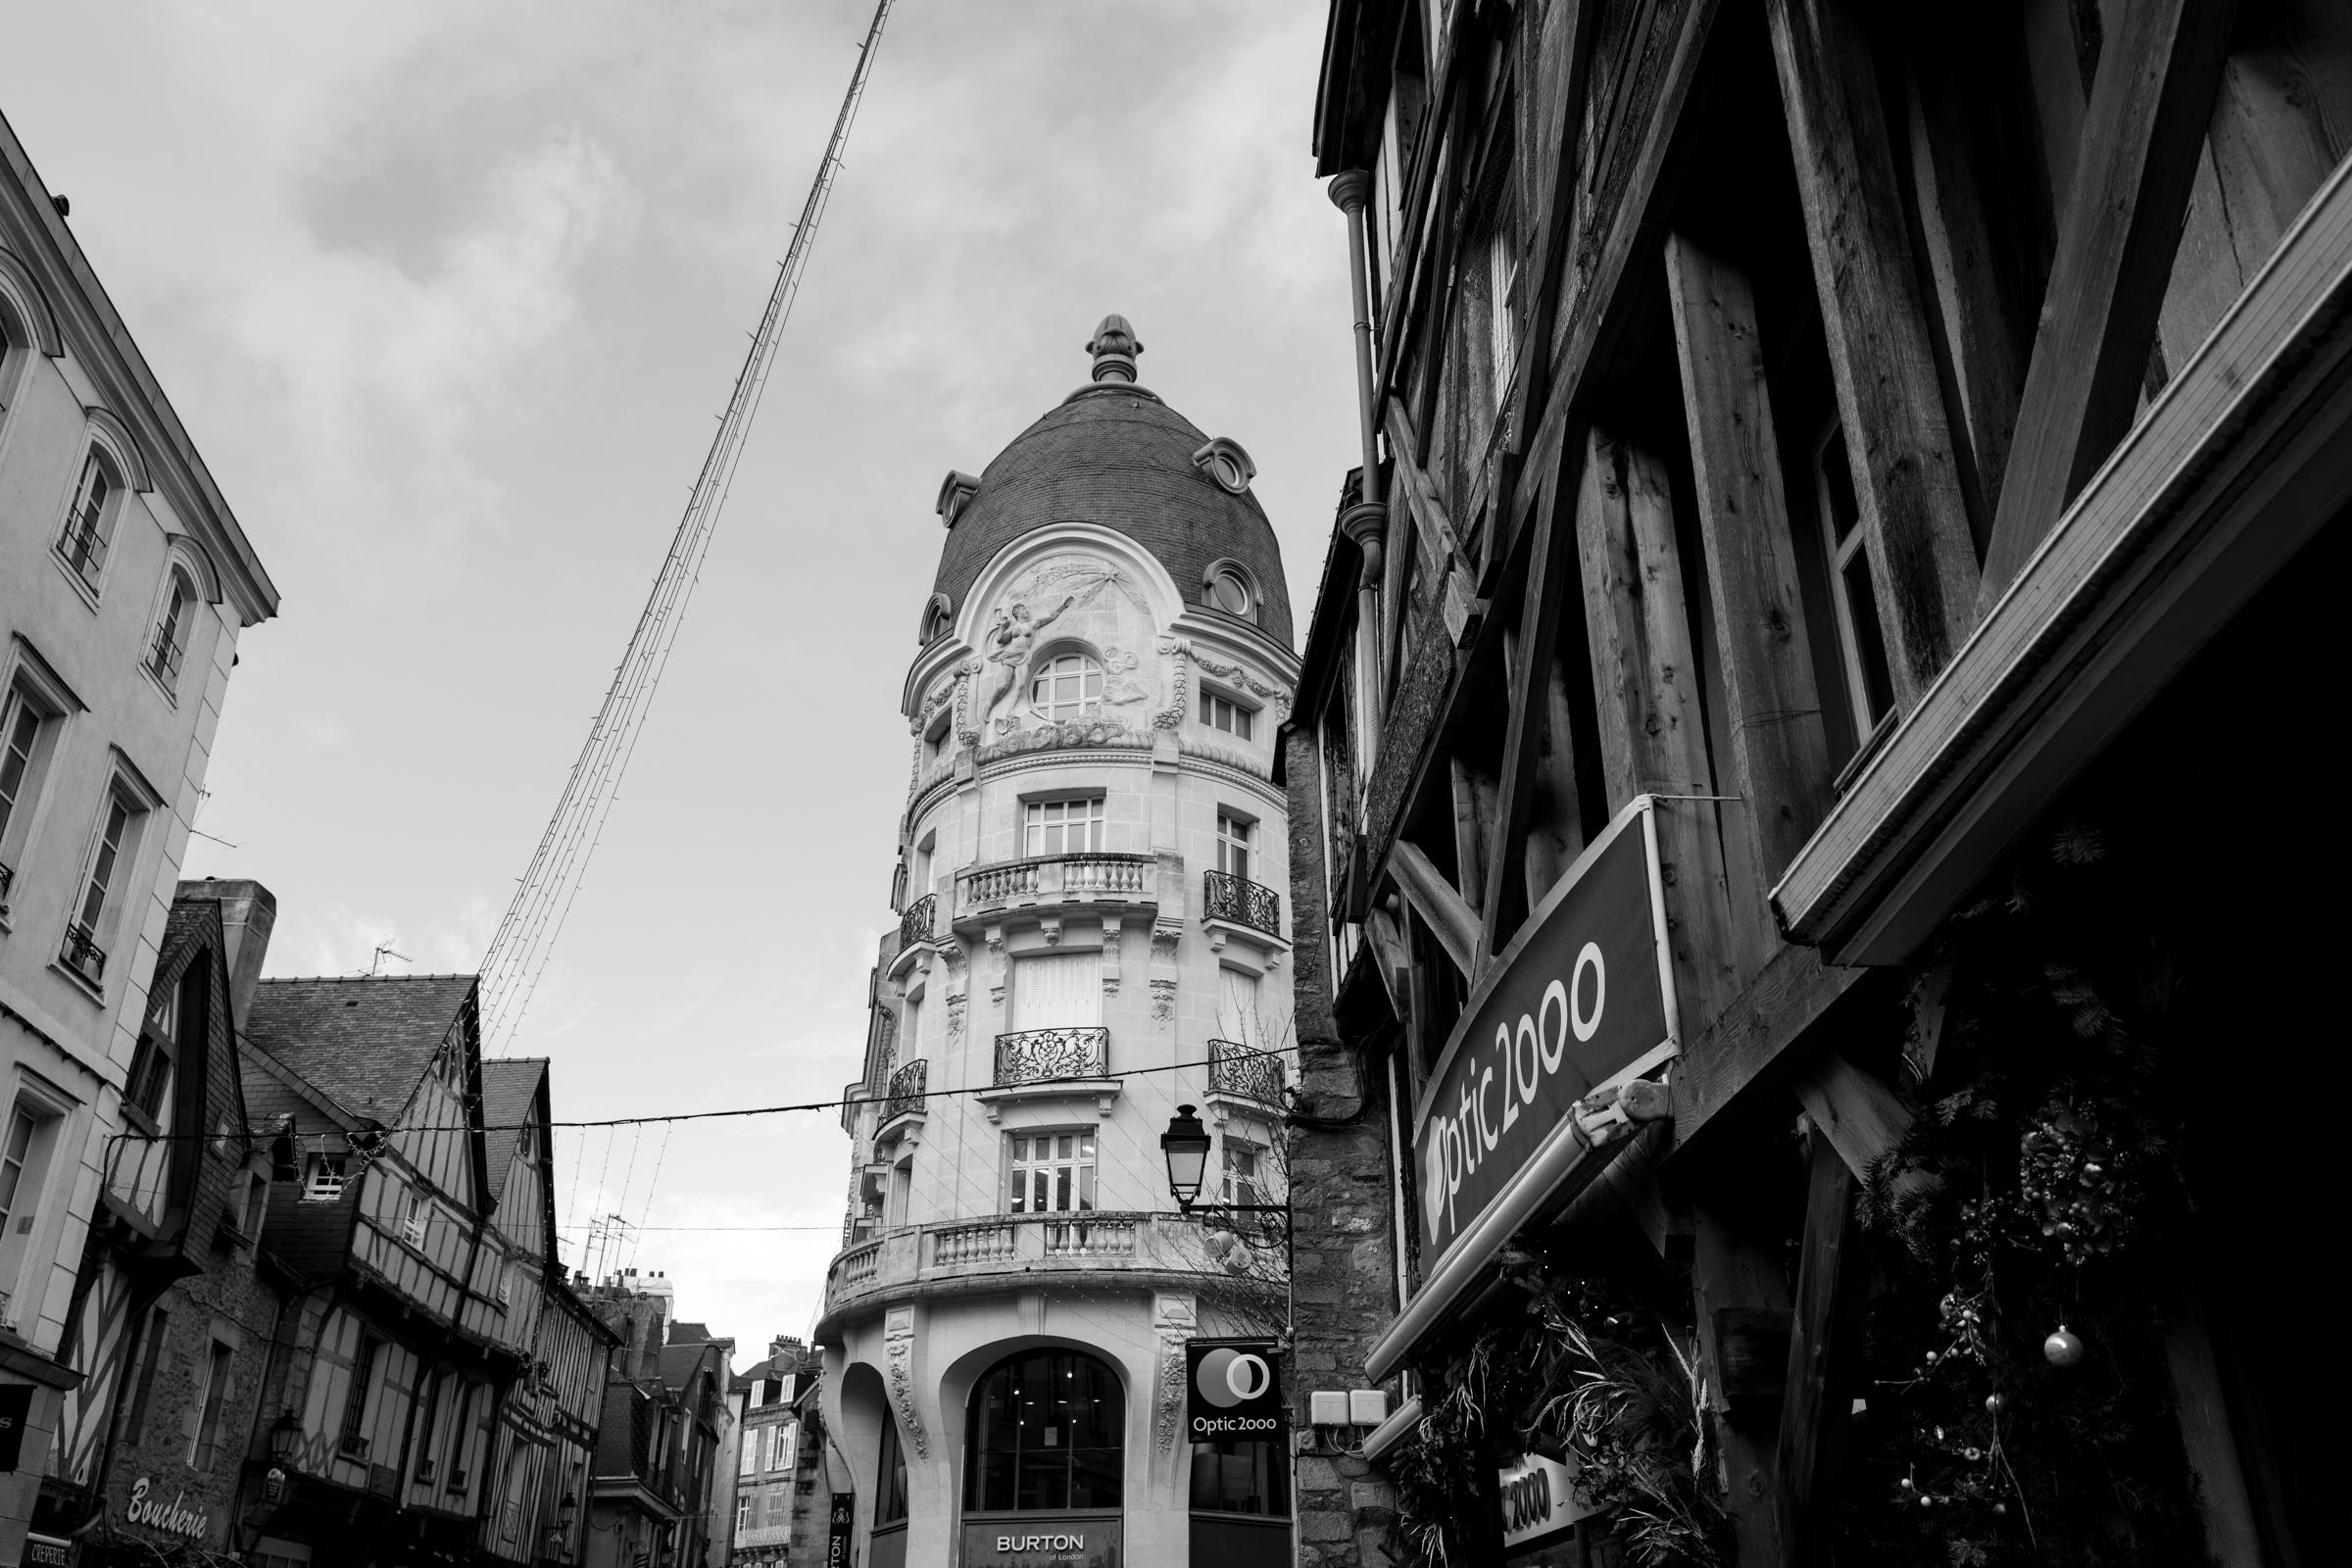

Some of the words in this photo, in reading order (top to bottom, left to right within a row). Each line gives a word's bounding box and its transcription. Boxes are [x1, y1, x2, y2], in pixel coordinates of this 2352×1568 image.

[1434, 1056, 1498, 1236] Optic
[1495, 941, 1606, 1135] 2000
[1193, 1416, 1237, 1437] Optic
[1238, 1416, 1277, 1431] 2000
[127, 1477, 208, 1540] Boucherie
[1509, 1467, 1551, 1530] 2000
[997, 1534, 1084, 1552] BURTON
[1058, 1552, 1084, 1561] London
